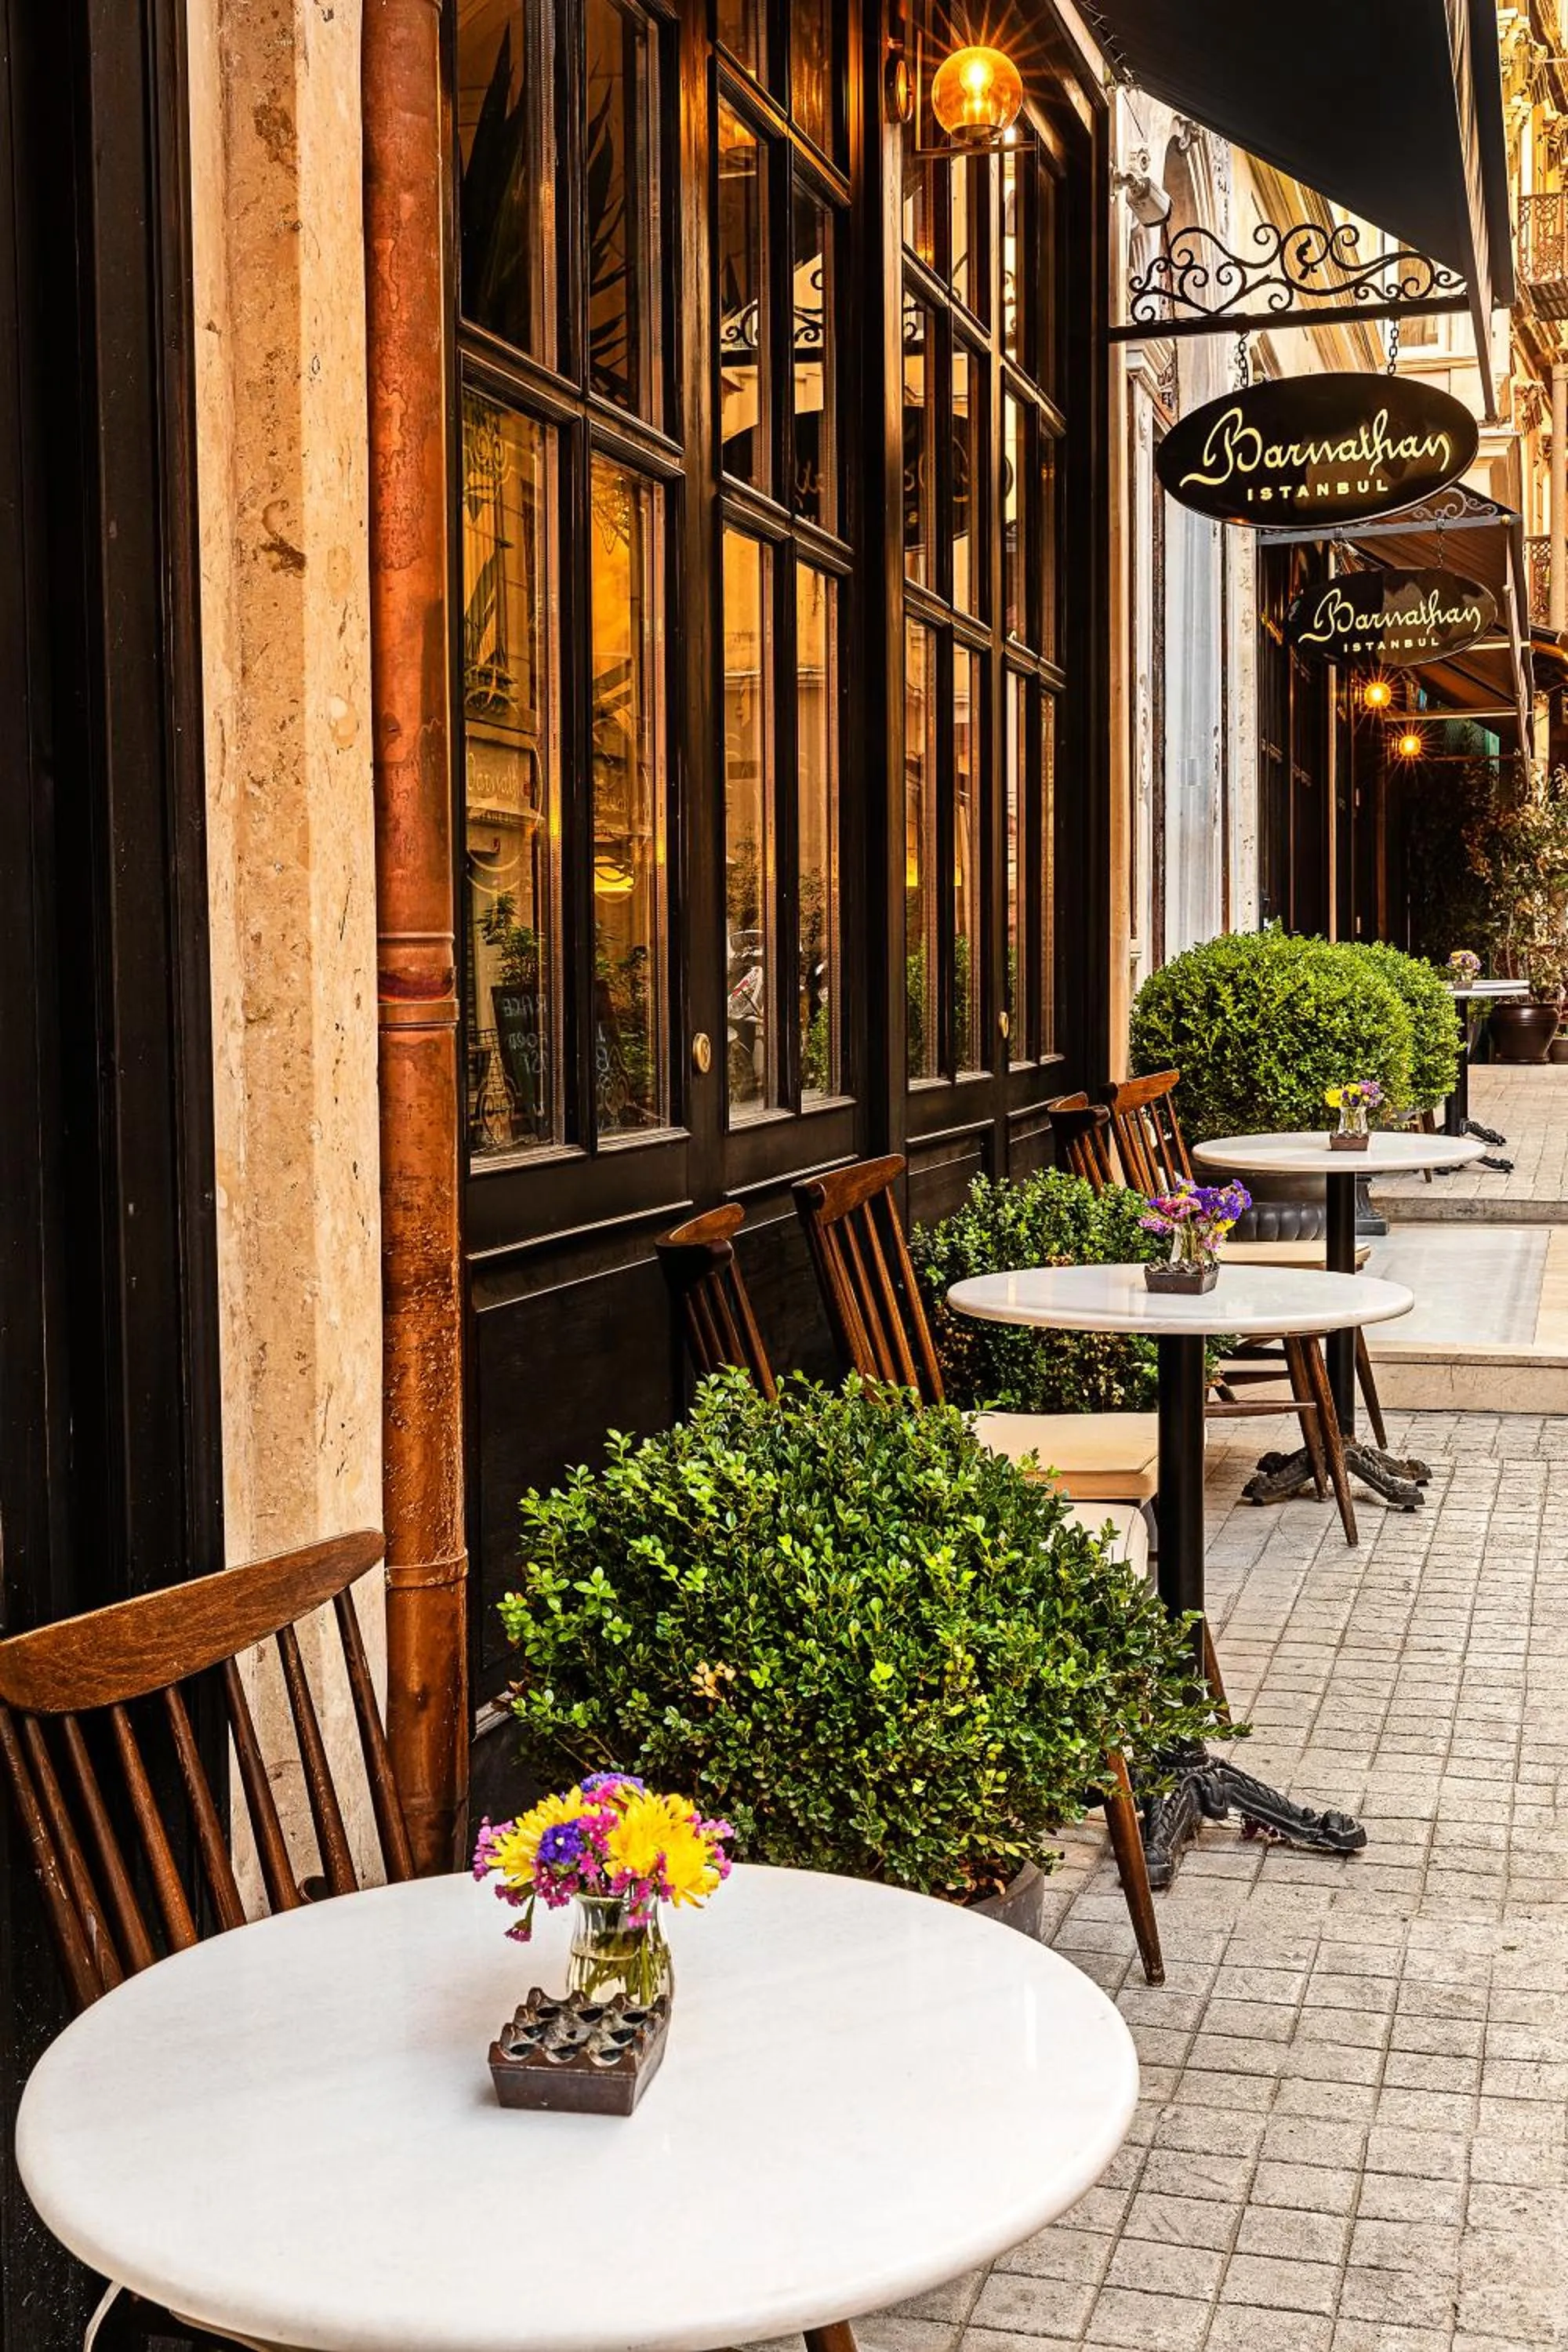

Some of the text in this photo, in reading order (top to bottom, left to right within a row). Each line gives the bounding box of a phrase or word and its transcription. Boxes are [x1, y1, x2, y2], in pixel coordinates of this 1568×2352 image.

[1179, 407, 1453, 488] Barnathan
[1247, 478, 1389, 503] ISTANBUL
[1298, 588, 1482, 644] Barnathan
[1343, 637, 1440, 654] ISTANBUL
